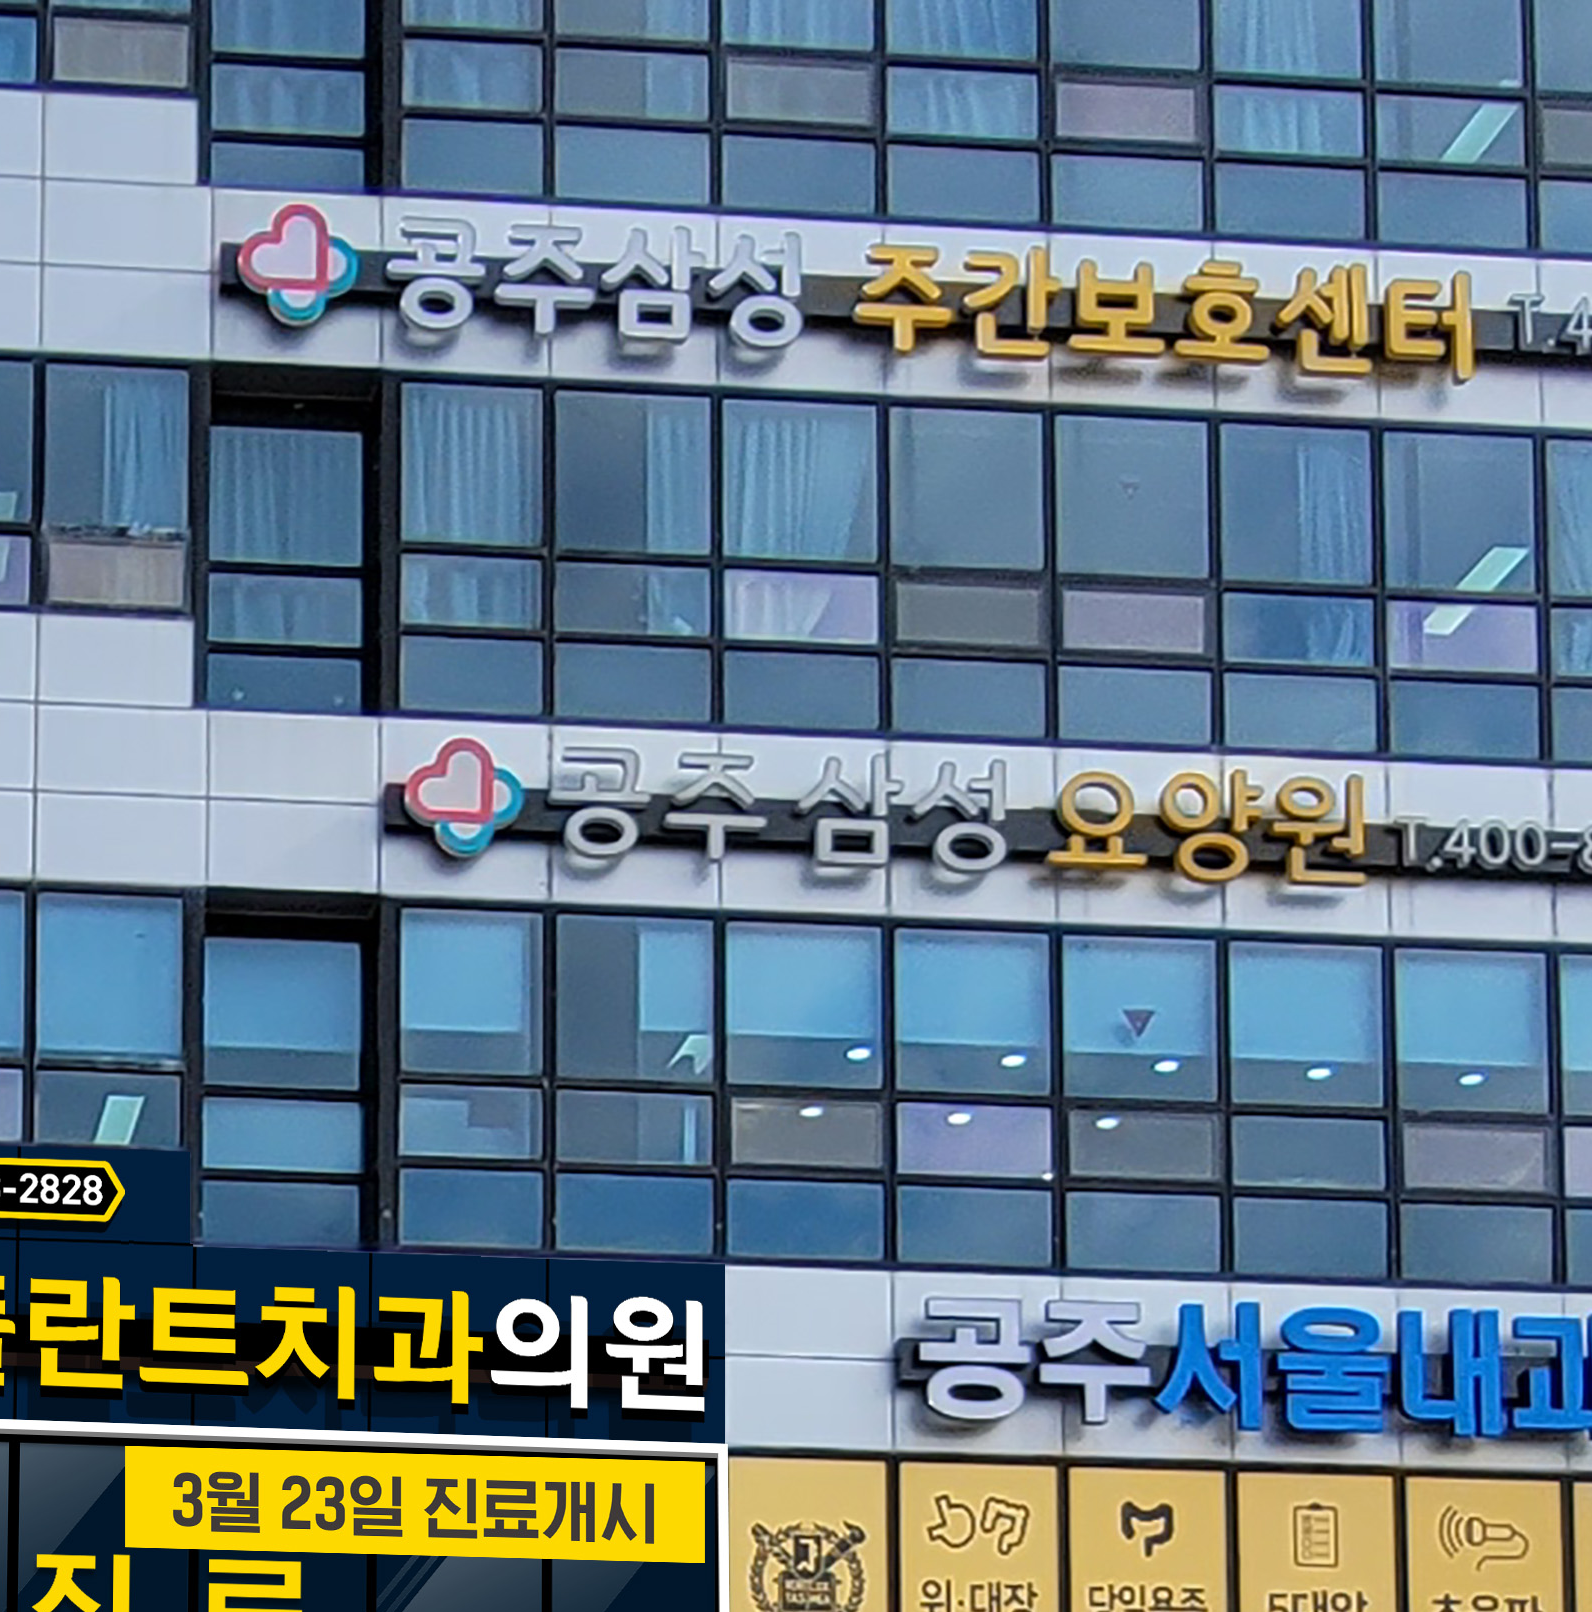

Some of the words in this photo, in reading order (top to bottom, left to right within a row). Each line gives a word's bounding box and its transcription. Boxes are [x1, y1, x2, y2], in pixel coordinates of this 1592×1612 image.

[387, 219, 805, 348] 공주삼성
[854, 241, 1477, 381] 주간보호센터
[1046, 769, 1367, 885] 요양원
[172, 1470, 266, 1533] 3월
[281, 1473, 404, 1538] 23일
[423, 1476, 657, 1547] 진료개시
